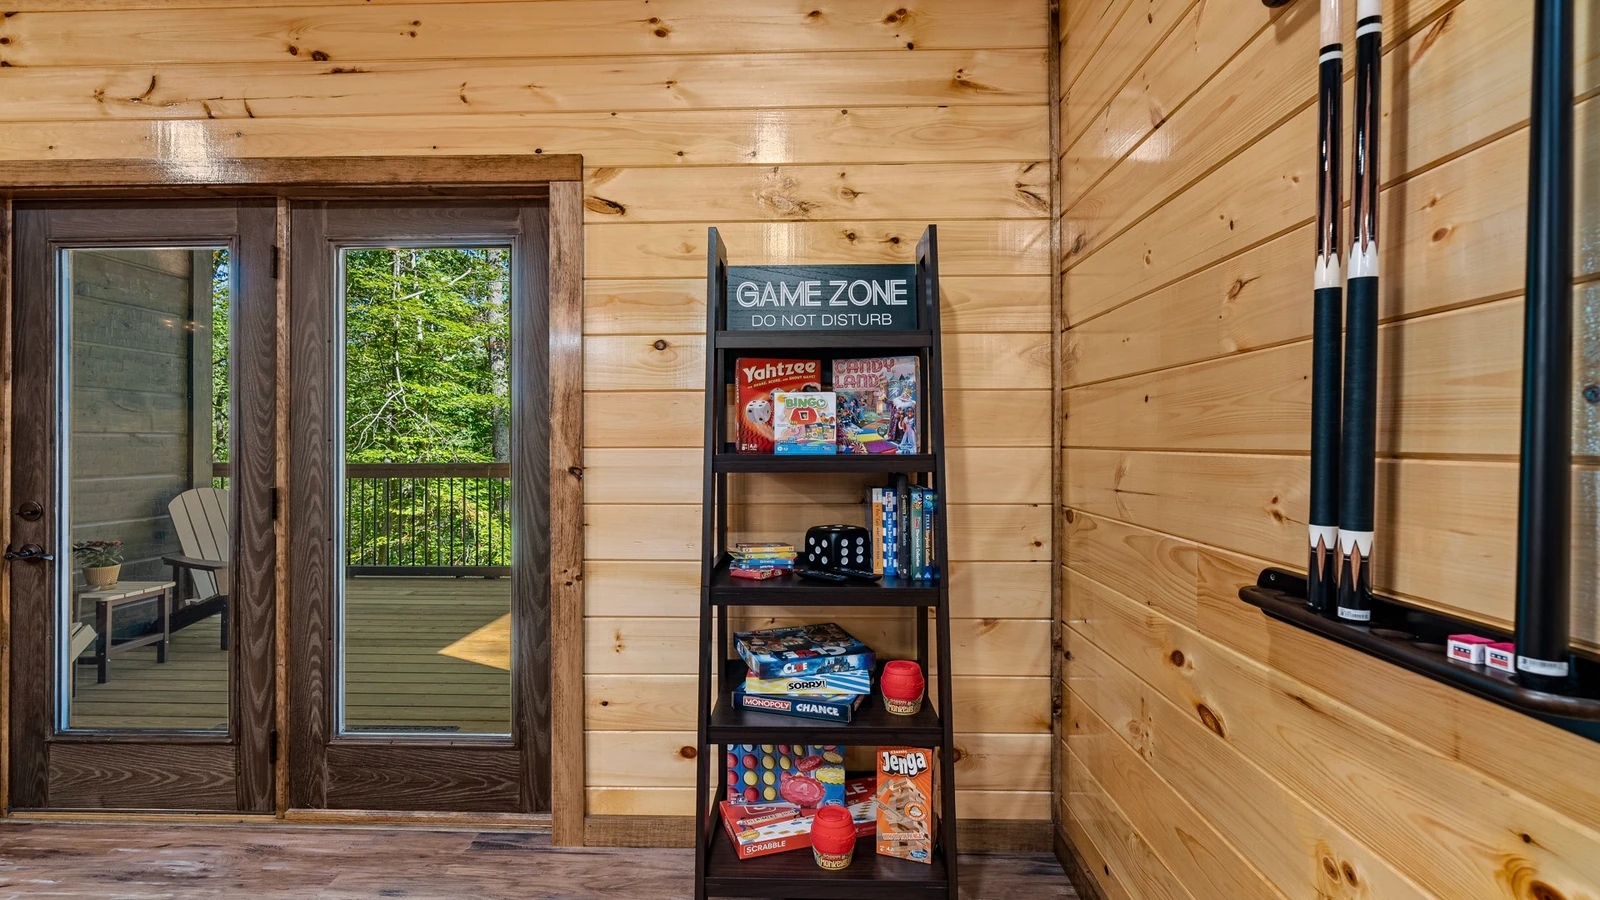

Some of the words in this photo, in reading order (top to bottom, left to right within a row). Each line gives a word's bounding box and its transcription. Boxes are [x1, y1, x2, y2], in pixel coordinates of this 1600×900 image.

[736, 280, 822, 308] GAME
[829, 279, 908, 307] ZONE
[752, 314, 777, 327] DO
[781, 314, 817, 327] NOT
[822, 313, 893, 326] DISTURB
[742, 361, 816, 384] Yahtzee
[834, 358, 895, 374] CANDY
[834, 374, 879, 389] LAND
[784, 397, 827, 409] BINGO
[783, 645, 847, 659] CLUE
[783, 662, 808, 674] CLUE
[788, 680, 826, 690] SORRY!
[744, 697, 790, 710] MONOPOLY
[796, 703, 840, 716] CHANCE
[882, 751, 927, 775] Jenga
[746, 840, 786, 854] SCRABBLE
